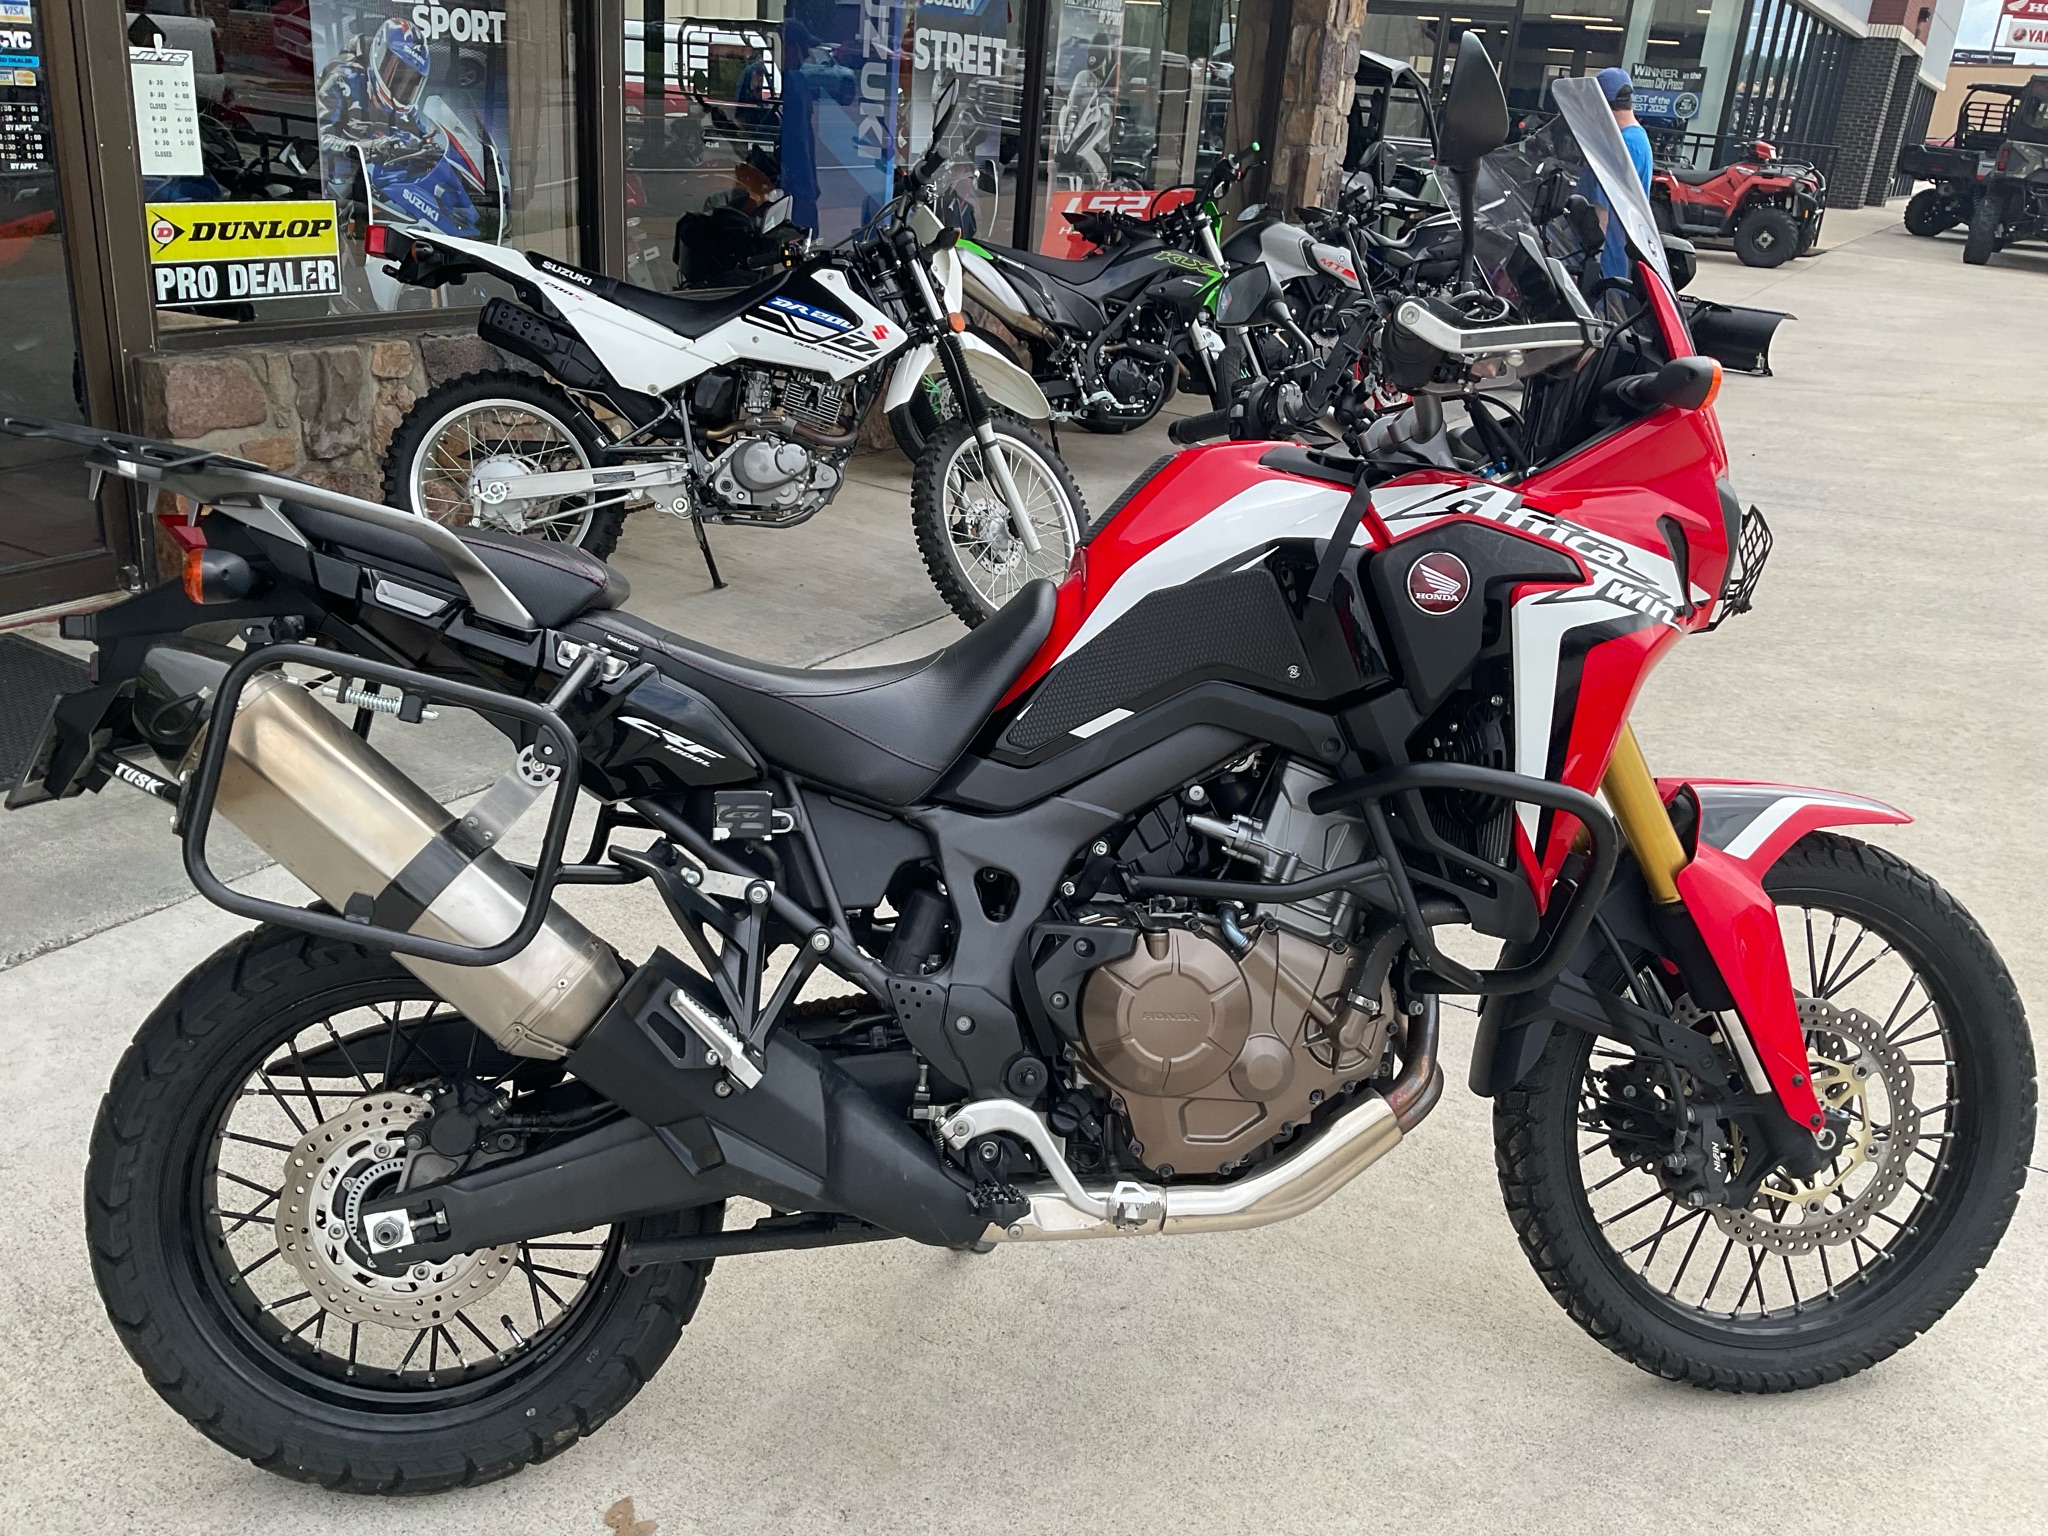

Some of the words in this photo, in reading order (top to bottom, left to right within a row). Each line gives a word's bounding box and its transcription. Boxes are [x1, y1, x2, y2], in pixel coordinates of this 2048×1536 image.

[4, 6, 24, 15] VISA
[412, 5, 506, 43] SPORT
[914, 28, 1007, 77] STREET
[1634, 64, 1678, 78] WINNER
[1654, 78, 1666, 91] City
[1666, 79, 1684, 90] Press
[1648, 95, 1657, 104] of
[1657, 97, 1670, 105] the
[1648, 104, 1667, 113] 2025
[10, 162, 20, 170] BY
[402, 188, 440, 222] SUZUKI
[188, 219, 332, 242] DUNLOP
[542, 260, 593, 286] SUZUKI
[1153, 250, 1215, 275] KLX
[1320, 258, 1345, 271] MT
[155, 264, 219, 301] PRO
[227, 259, 337, 297] DEALER
[1455, 484, 1630, 570] Africa
[1415, 592, 1460, 602] HONDA
[617, 715, 727, 759] CRF
[114, 762, 165, 794] TUSK
[1141, 1011, 1201, 1021] HONDA
[1711, 1140, 1722, 1173] NISSIN
